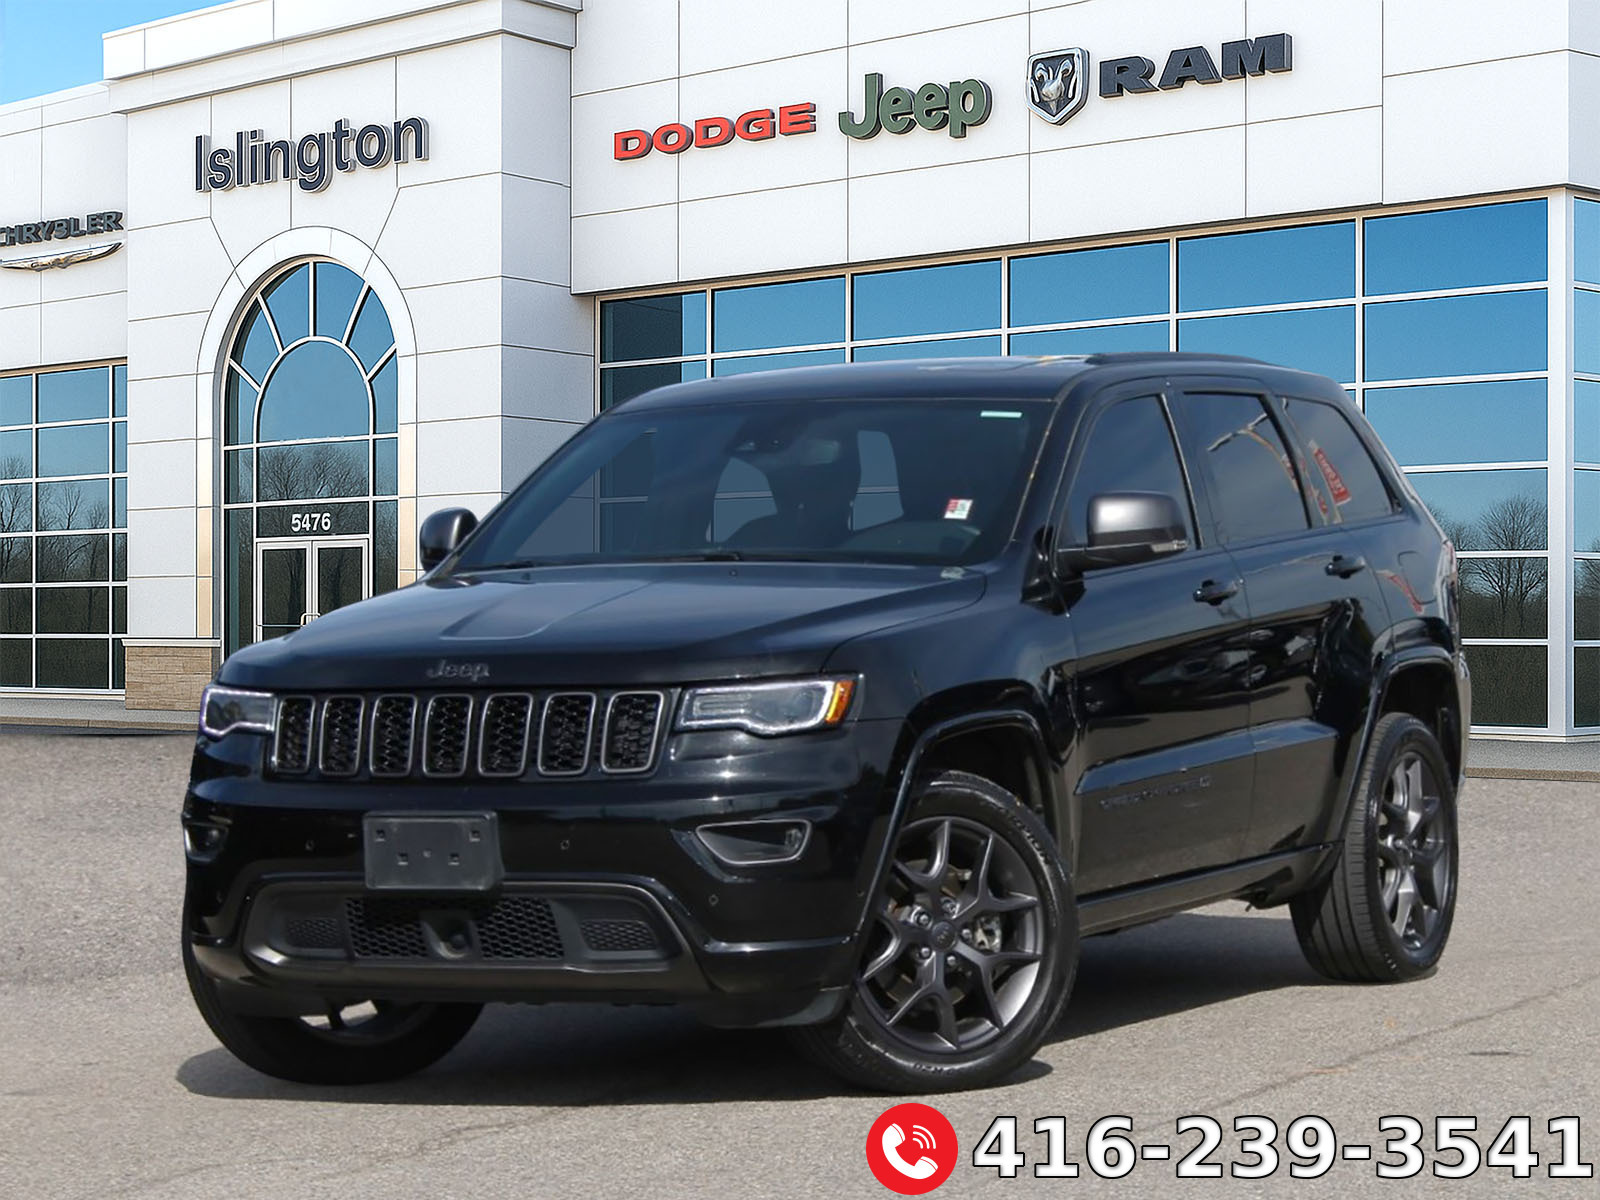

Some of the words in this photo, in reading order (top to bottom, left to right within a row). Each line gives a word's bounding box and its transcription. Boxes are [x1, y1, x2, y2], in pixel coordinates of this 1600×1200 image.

[1099, 33, 1293, 98] RAM
[613, 102, 817, 161] DODGE
[838, 72, 992, 140] Jeep
[195, 116, 429, 192] Islington
[291, 512, 331, 532] 5476
[426, 659, 490, 681] Jeep
